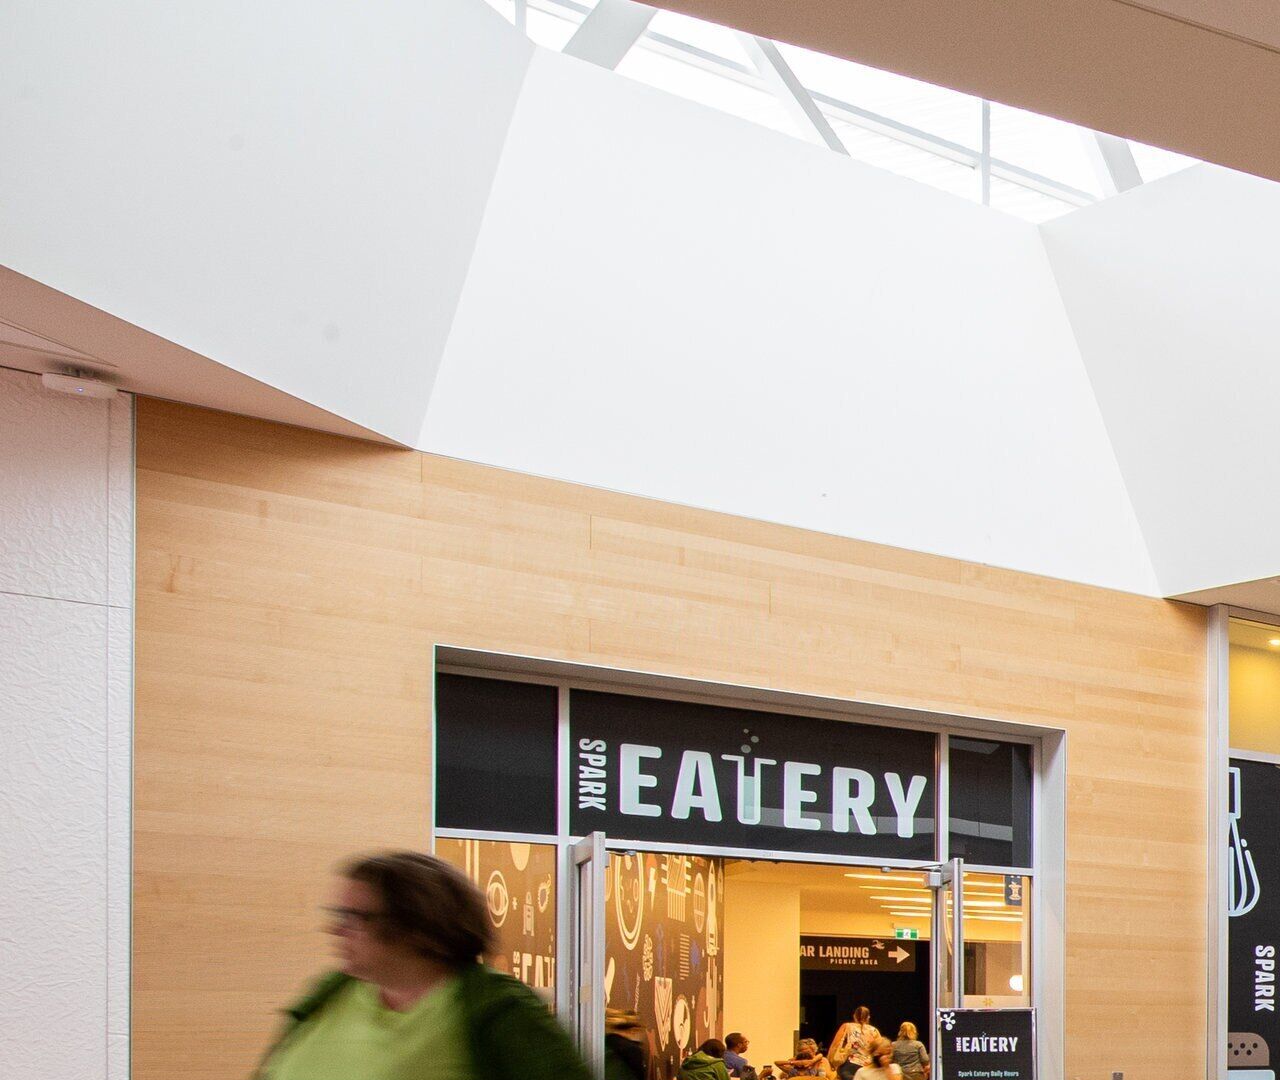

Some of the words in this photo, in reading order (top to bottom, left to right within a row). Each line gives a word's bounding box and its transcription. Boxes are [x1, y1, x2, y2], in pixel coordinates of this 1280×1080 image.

[579, 738, 607, 811] SPARK
[619, 743, 927, 838] EATERY
[800, 945, 815, 957] AR
[819, 945, 869, 959] LANDING
[1254, 945, 1275, 1012] SPARK
[962, 1036, 1018, 1053] EATERY
